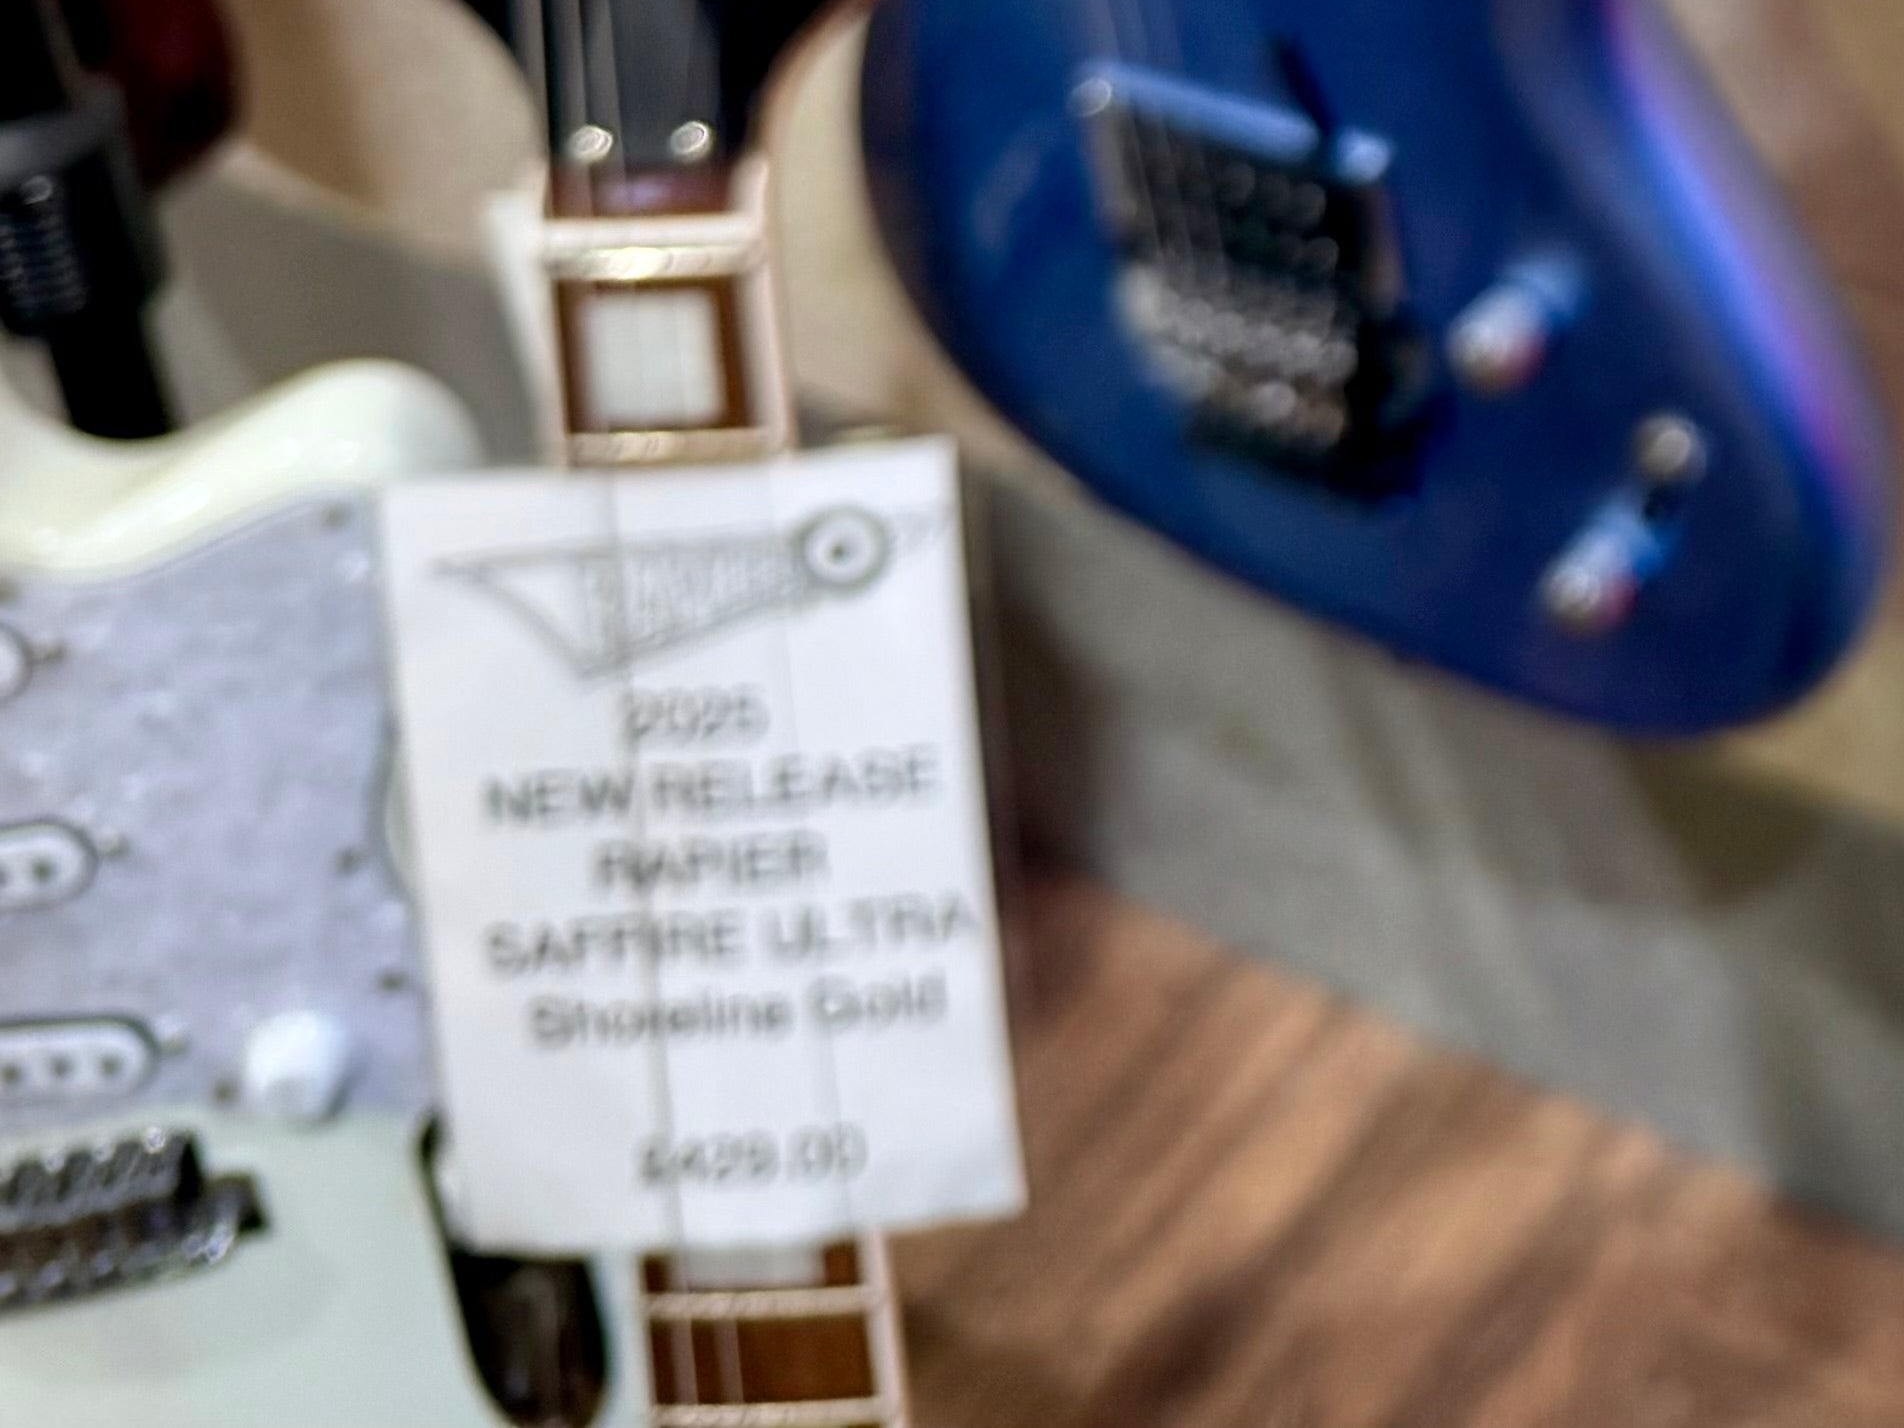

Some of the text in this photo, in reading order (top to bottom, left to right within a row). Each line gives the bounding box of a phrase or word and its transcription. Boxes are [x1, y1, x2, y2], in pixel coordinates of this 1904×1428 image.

[482, 746, 942, 828] NEW RELEASE
[593, 832, 828, 896] RAPIER
[762, 890, 980, 966] ULTRA
[527, 970, 950, 1052] Shoreline Gold
